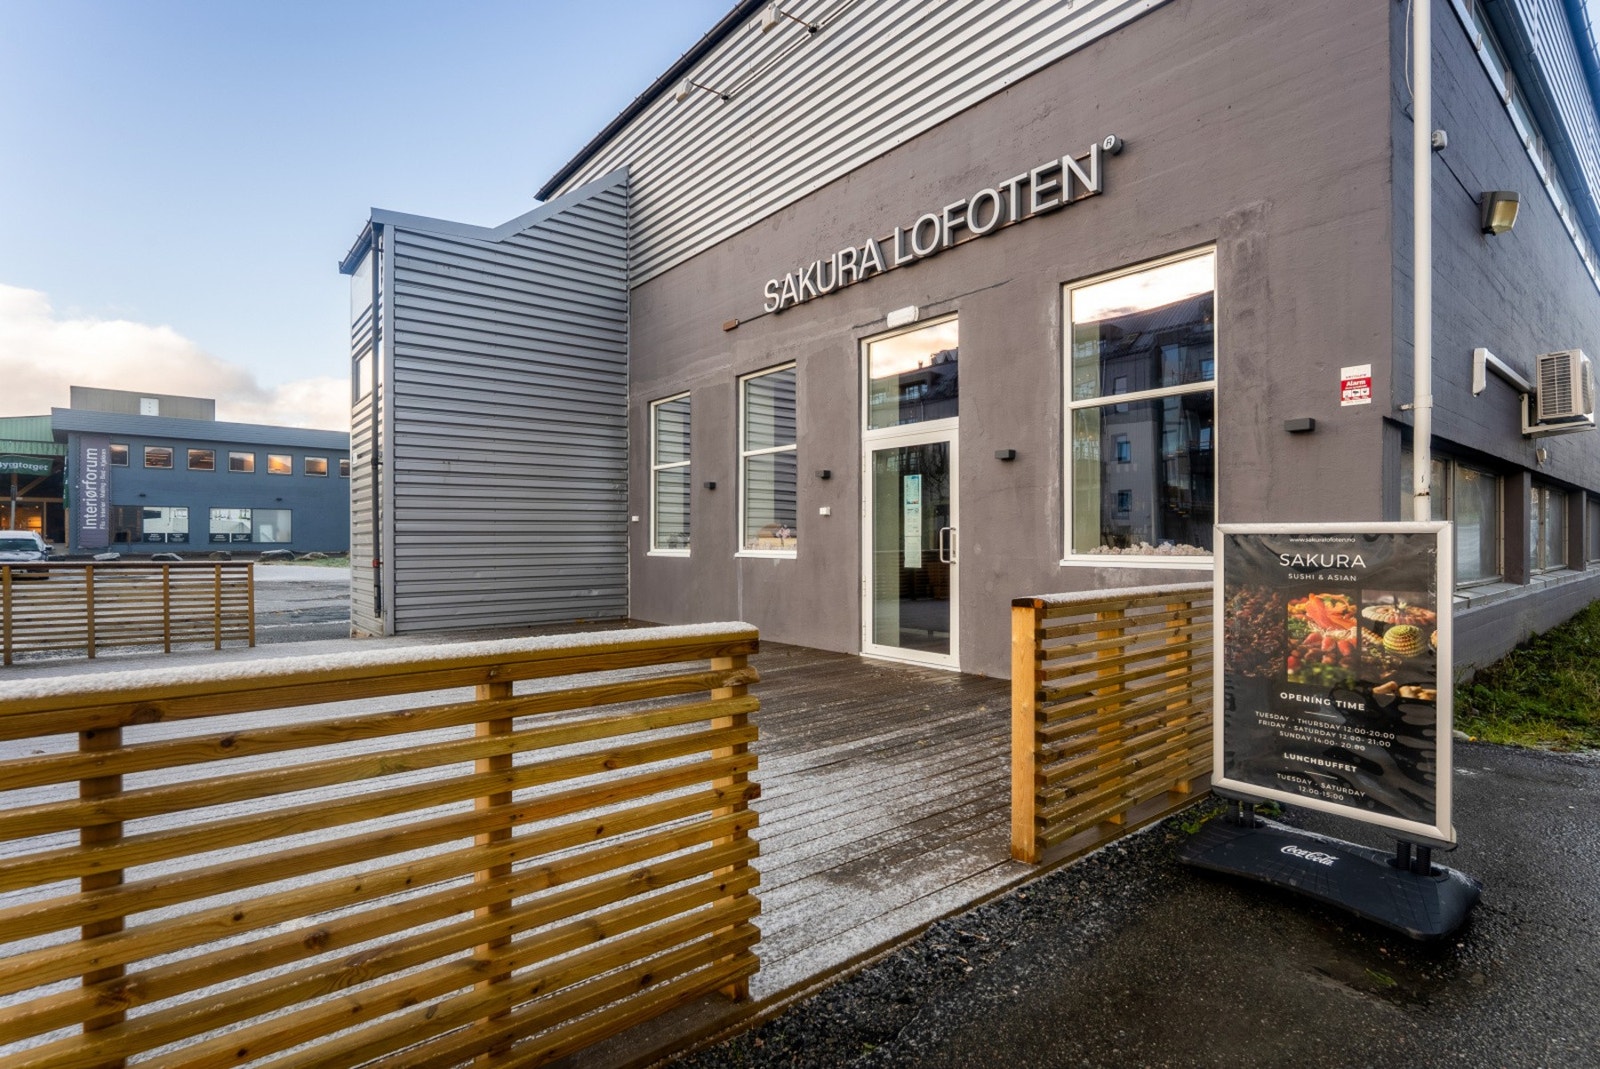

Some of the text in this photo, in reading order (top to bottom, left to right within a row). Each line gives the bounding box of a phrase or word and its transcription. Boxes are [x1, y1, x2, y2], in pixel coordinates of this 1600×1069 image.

[764, 238, 884, 313] SAKURA
[894, 143, 1101, 265] LOFOTEN
[82, 447, 98, 529] Interiørforum
[1279, 553, 1366, 568] SAKURA
[1327, 574, 1357, 582] ASIAN
[1280, 692, 1365, 711] OPENING TIME
[1255, 711, 1290, 721] TUESDAY
[1298, 718, 1341, 731] THURSDAY
[1258, 719, 1286, 729] FRIDAY
[1294, 725, 1336, 738] SATURDAY
[1368, 738, 1391, 748] 21:00
[1280, 730, 1312, 742] SUNDAY
[1283, 752, 1357, 772] LUNCHBUFFET
[1276, 773, 1312, 785] TUESDAY
[1320, 782, 1366, 797] SATURDAY
